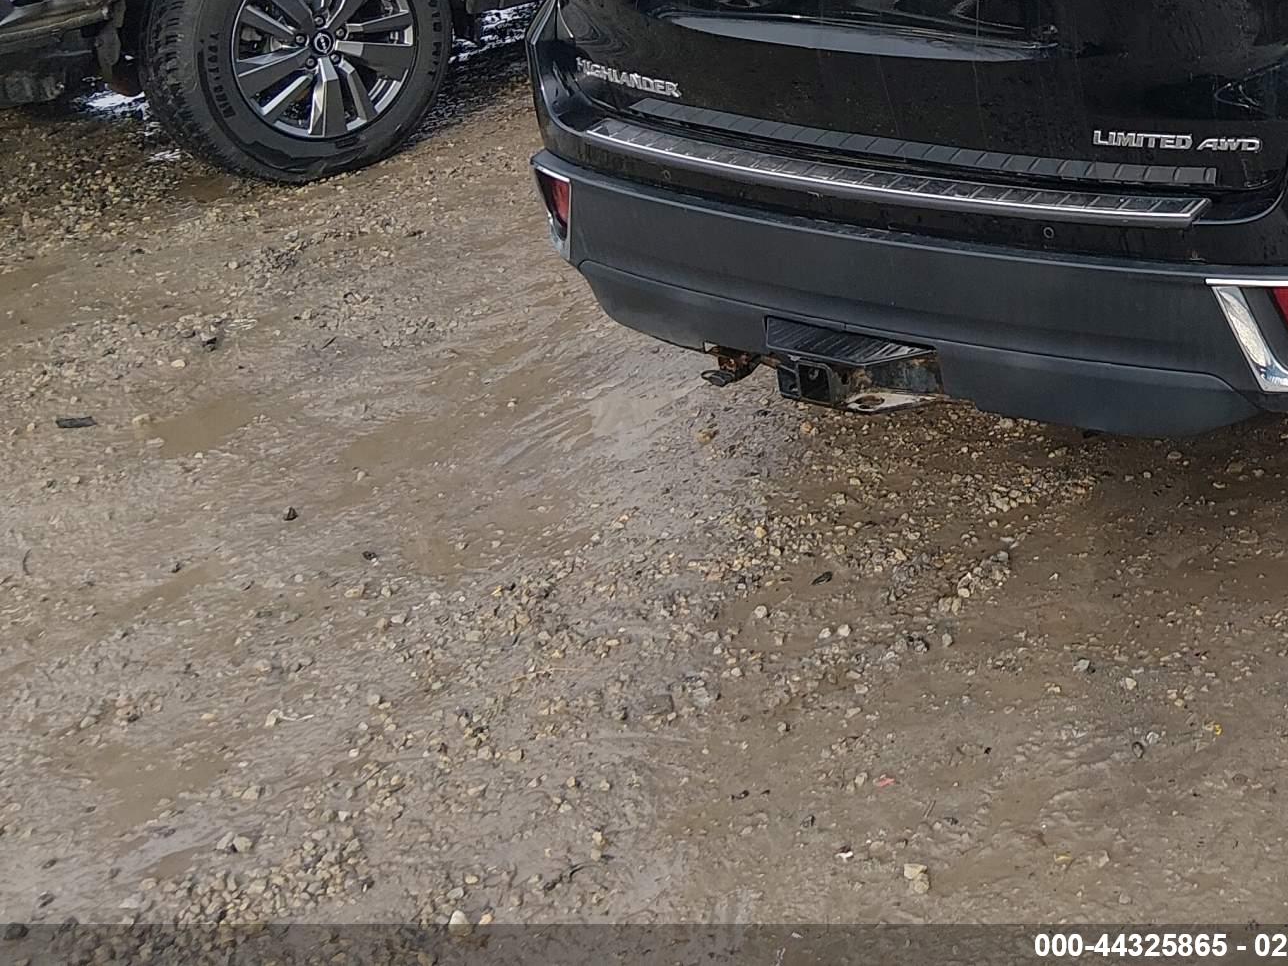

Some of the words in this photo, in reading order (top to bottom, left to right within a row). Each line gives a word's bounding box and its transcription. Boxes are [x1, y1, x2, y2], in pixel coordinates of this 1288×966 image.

[576, 56, 682, 98] HIGHLANDER
[1093, 130, 1193, 151] LIMITED
[1196, 137, 1263, 153] AWD
